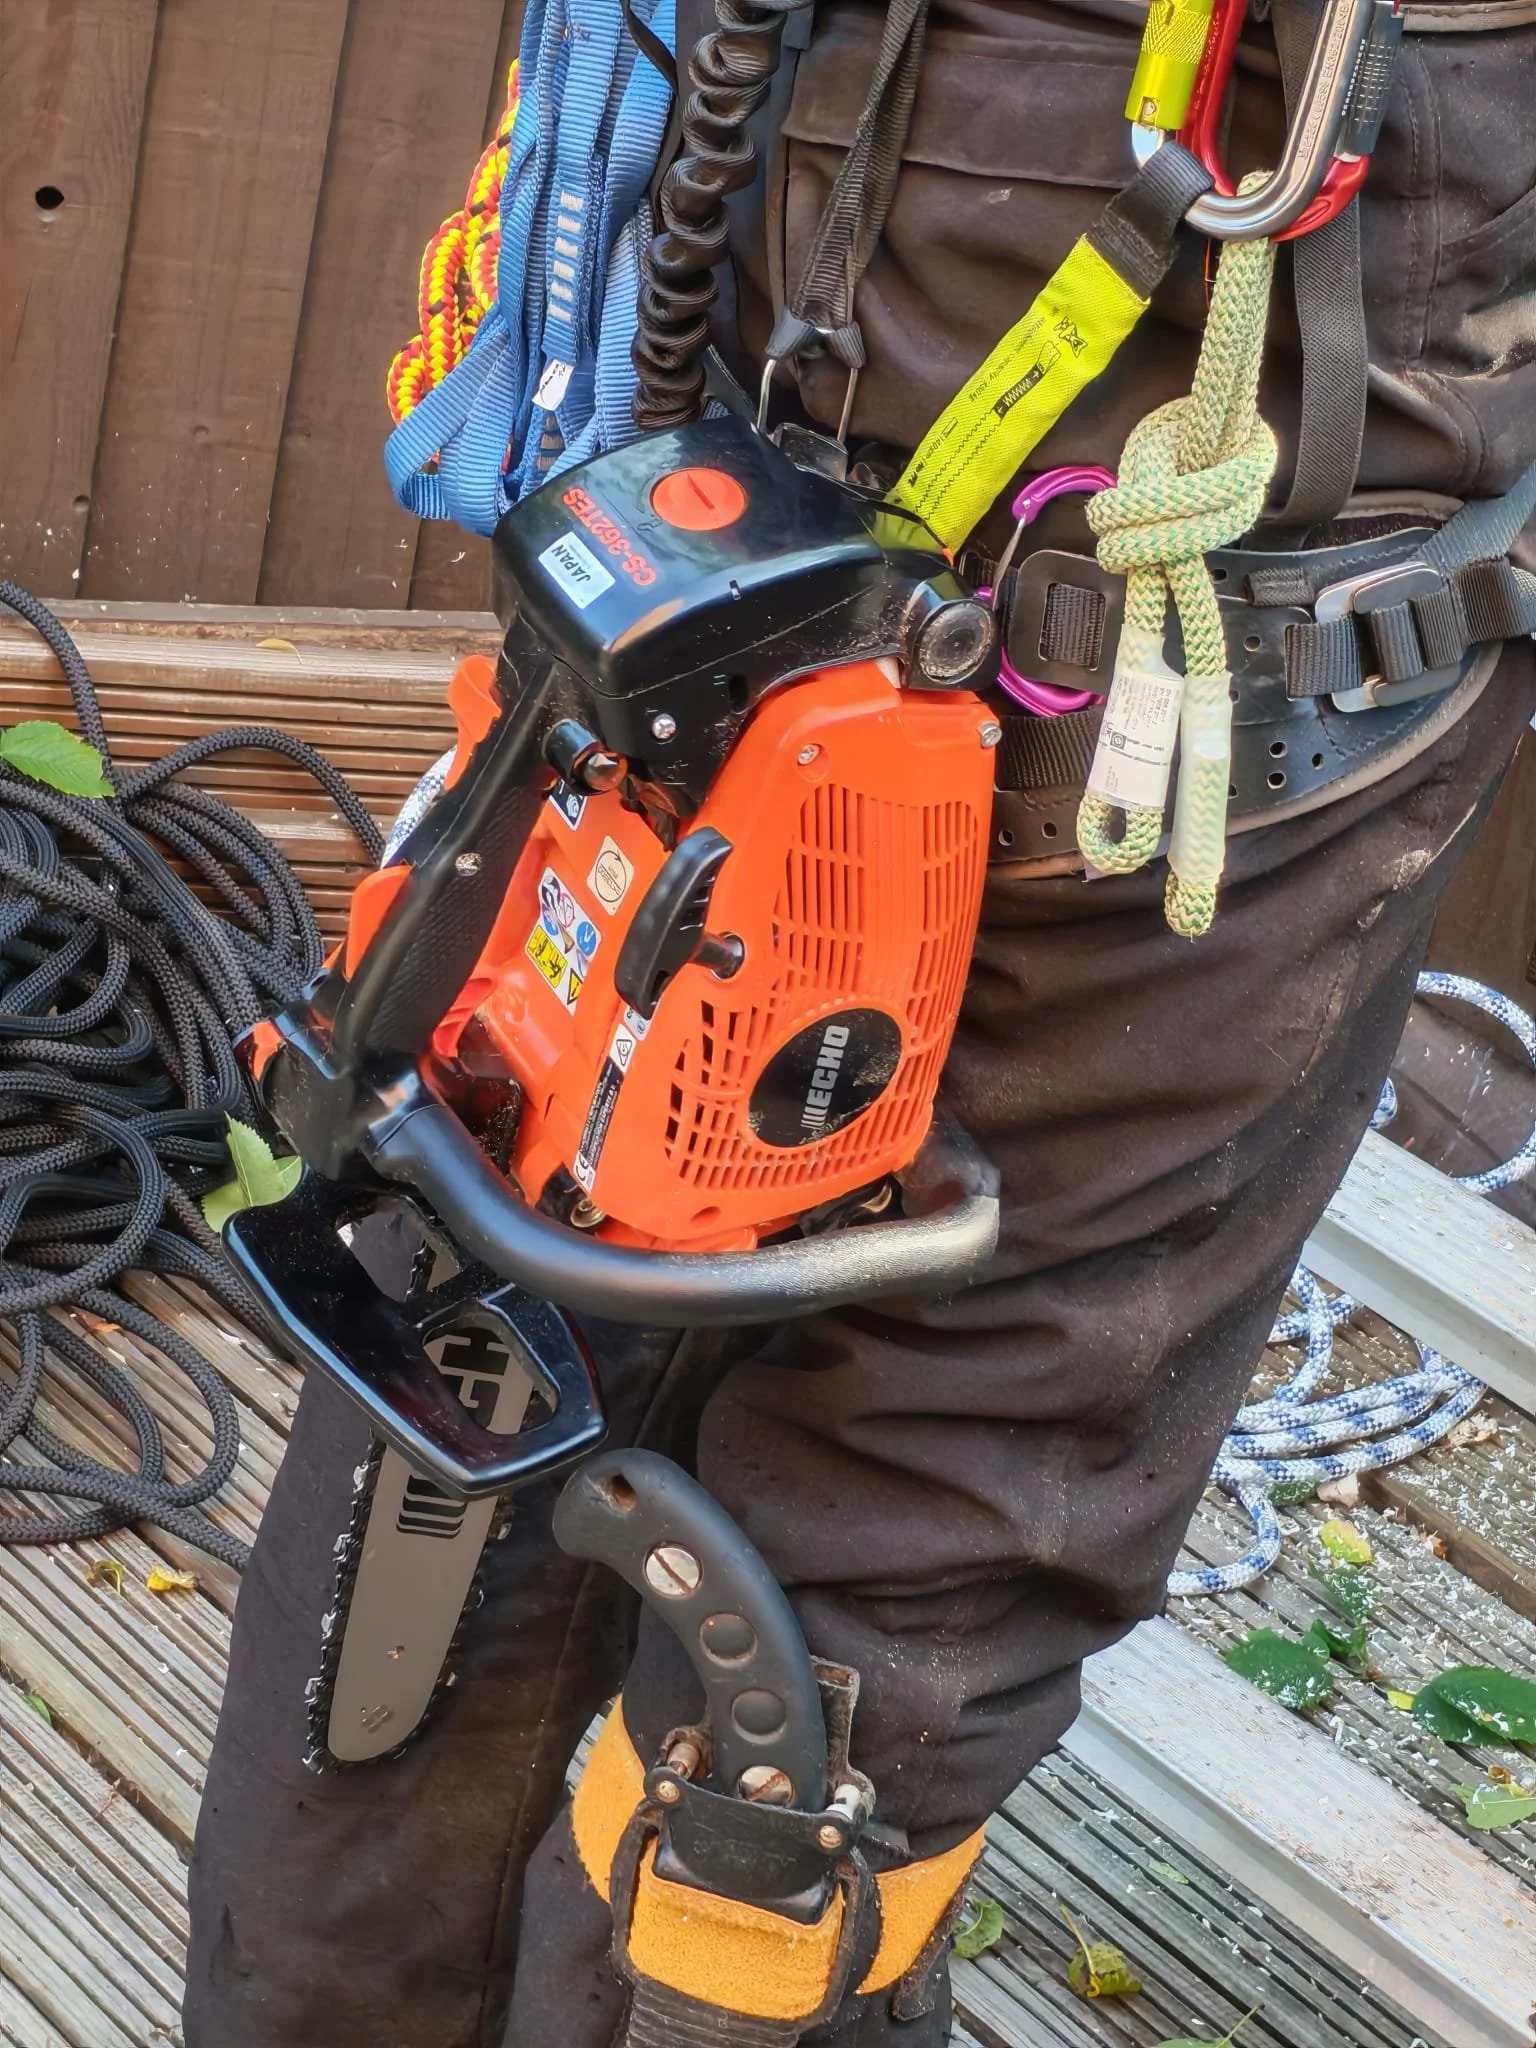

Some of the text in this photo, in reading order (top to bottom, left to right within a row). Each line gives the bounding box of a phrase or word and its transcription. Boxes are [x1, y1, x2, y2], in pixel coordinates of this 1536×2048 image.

[551, 544, 591, 582] JAPAN
[563, 487, 656, 586] CS-362TES
[806, 1025, 850, 1108] ECHO
